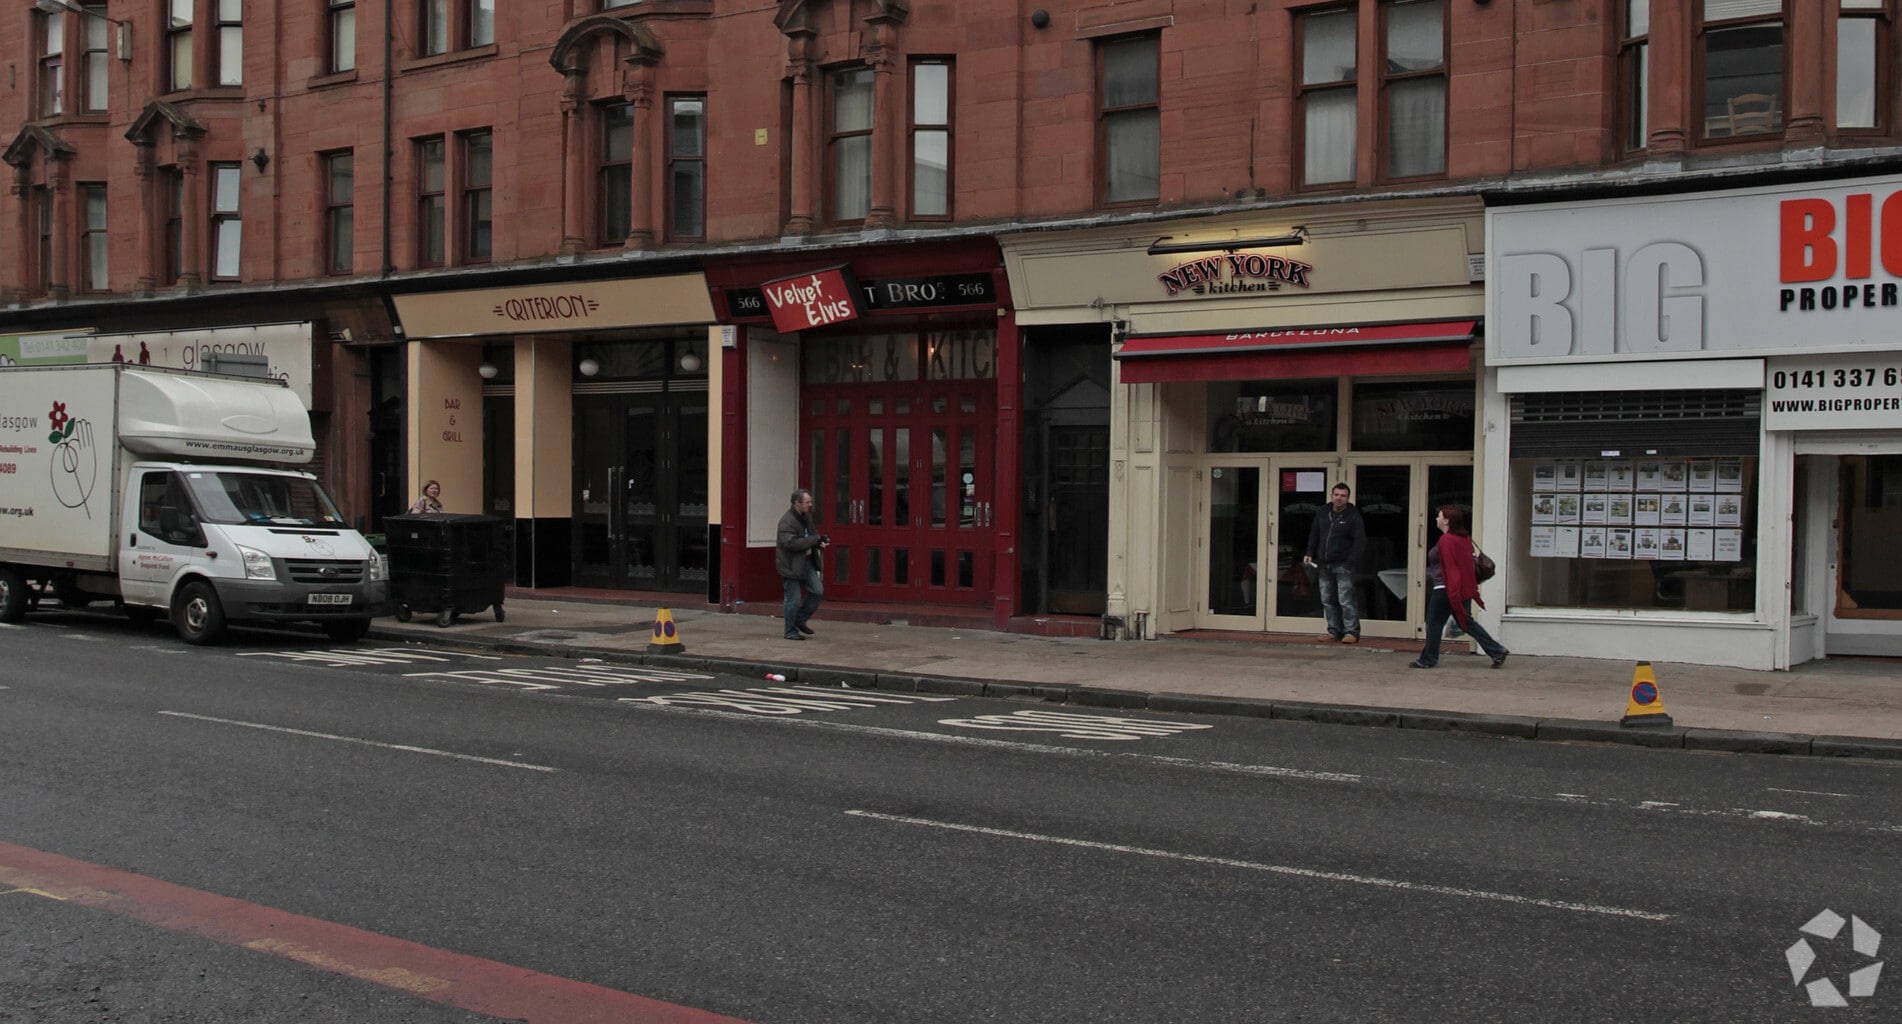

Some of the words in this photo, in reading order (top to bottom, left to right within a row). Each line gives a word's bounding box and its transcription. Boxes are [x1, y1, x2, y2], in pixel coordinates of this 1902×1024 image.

[1158, 255, 1222, 296] NEW
[1225, 253, 1312, 288] YORK
[766, 274, 822, 308] Velvet
[958, 282, 985, 296] 566
[1208, 280, 1266, 294] kitchen
[737, 296, 761, 309] 566
[1500, 241, 1703, 356] BIG
[1780, 283, 1902, 311] PROPER
[505, 295, 588, 321] CRITERION
[803, 294, 851, 325] Elvis
[1774, 370, 1825, 389] 0141
[1834, 368, 1876, 387] 337
[1884, 367, 1902, 386] 6
[445, 398, 460, 409] BAR
[1772, 398, 1902, 412] WWW.BIGPROPER
[442, 430, 463, 443] GRILL
[185, 440, 304, 456] www.emmausglasgow.org.uk
